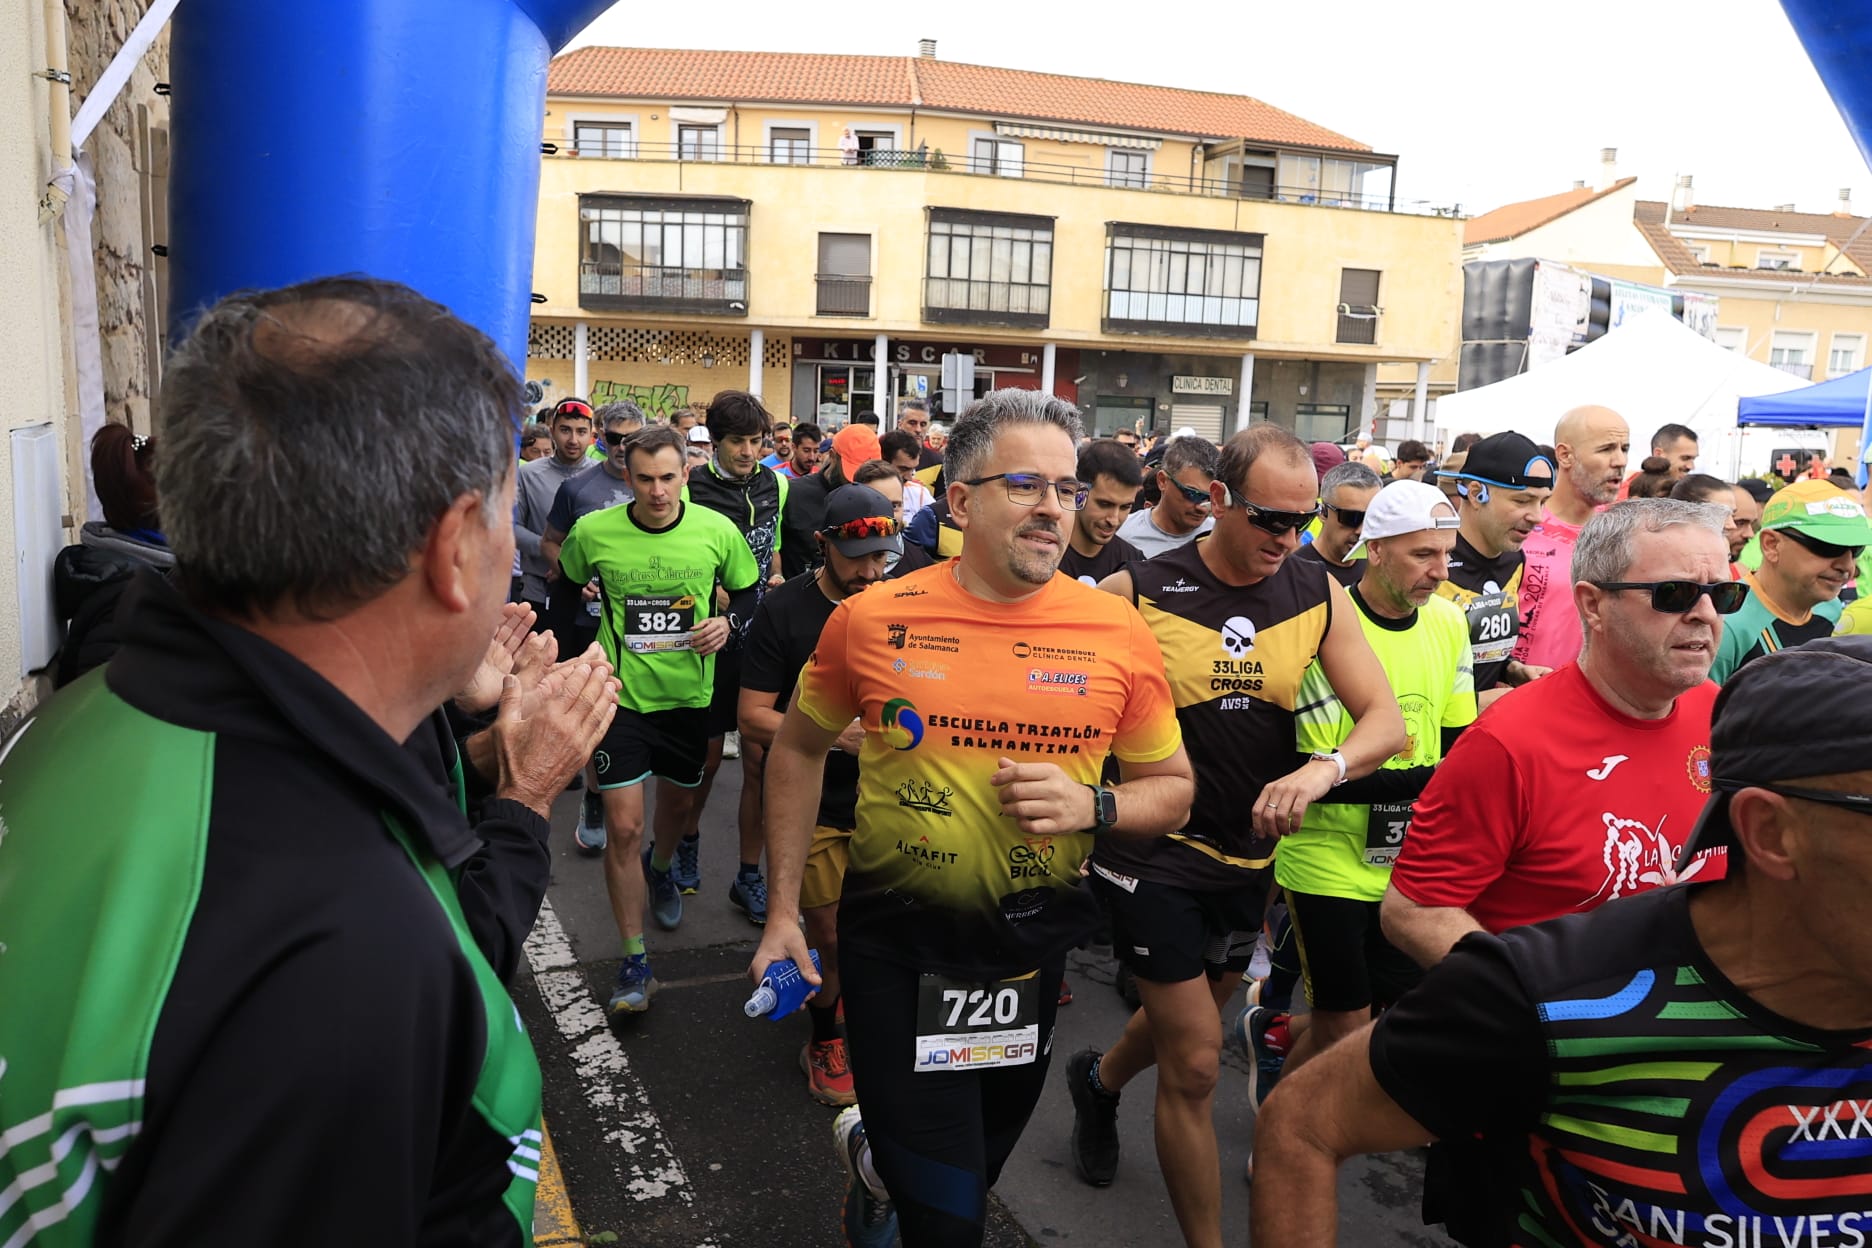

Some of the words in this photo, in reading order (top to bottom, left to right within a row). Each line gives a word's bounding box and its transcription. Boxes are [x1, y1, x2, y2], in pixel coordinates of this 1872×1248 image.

[1204, 378, 1231, 391] DENTAL
[1524, 563, 1545, 602] 2024
[638, 612, 681, 632] 382
[1479, 612, 1511, 641] 260
[909, 633, 960, 645] Ayuntamiento
[919, 643, 959, 653] Salamanca
[1067, 655, 1096, 663] DENTAL
[1053, 673, 1087, 685] ELICES
[1210, 678, 1264, 691] CROSS
[928, 714, 1009, 733] ESCUELA
[1016, 723, 1101, 739] TRIATLÓN
[951, 736, 1080, 754] SALMANTINA
[1372, 804, 1383, 812] 33
[1383, 804, 1401, 812] LIGA
[895, 840, 958, 864] ALTAFIT
[1644, 848, 1659, 867] LA
[942, 987, 1019, 1027] 720
[919, 1043, 1035, 1065] JOMISAGA
